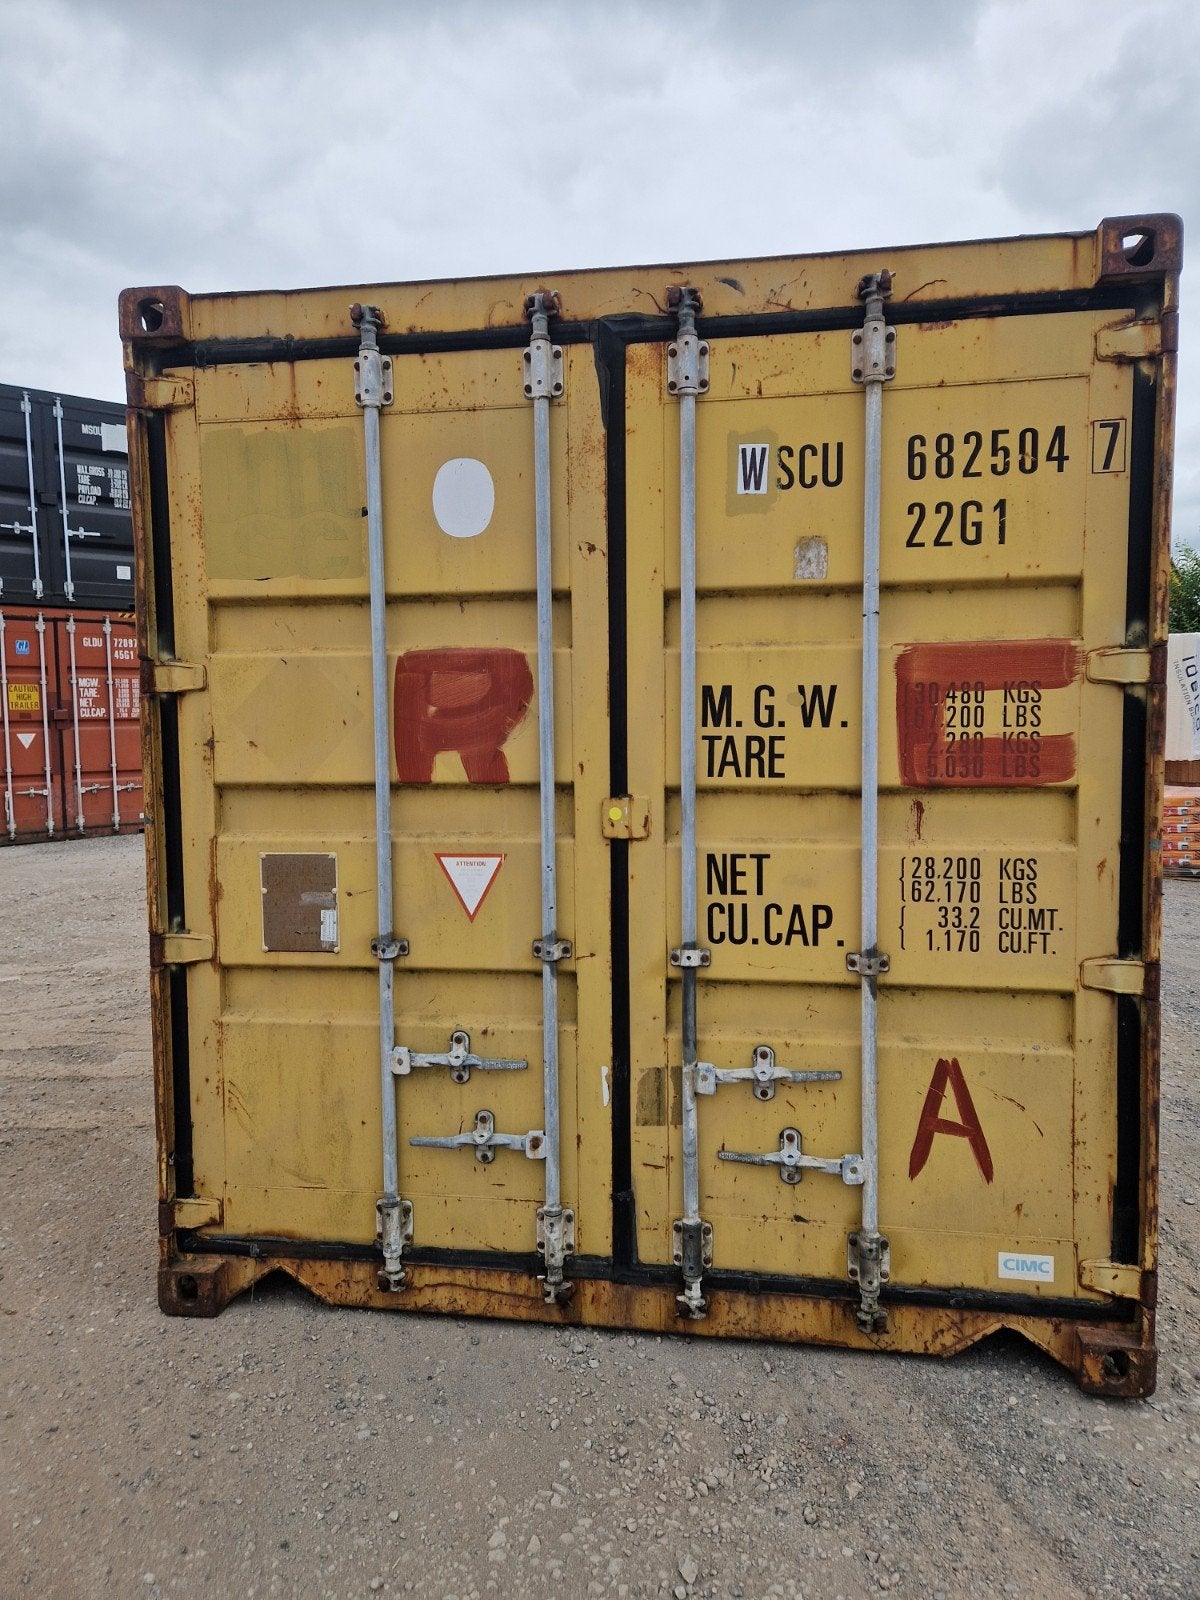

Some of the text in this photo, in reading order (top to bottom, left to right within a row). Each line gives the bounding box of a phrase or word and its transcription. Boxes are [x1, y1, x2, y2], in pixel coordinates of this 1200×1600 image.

[742, 421, 1122, 491] WSCU 682504 7
[906, 499, 1007, 547] 22G1
[82, 637, 103, 647] GLDU
[1003, 681, 1042, 704] KGS
[10, 701, 39, 709] TRAILER
[1002, 704, 1042, 728] LBS
[702, 735, 786, 778] TARE
[706, 853, 771, 895] NET
[999, 857, 1038, 881] KGS
[999, 882, 1037, 904] LBS
[707, 902, 1063, 947] CU.CAP. 33.2 CU.MT.
[999, 931, 1056, 955] CU.FT.
[909, 1057, 994, 1185] A
[1003, 1258, 1050, 1274] CIMC
